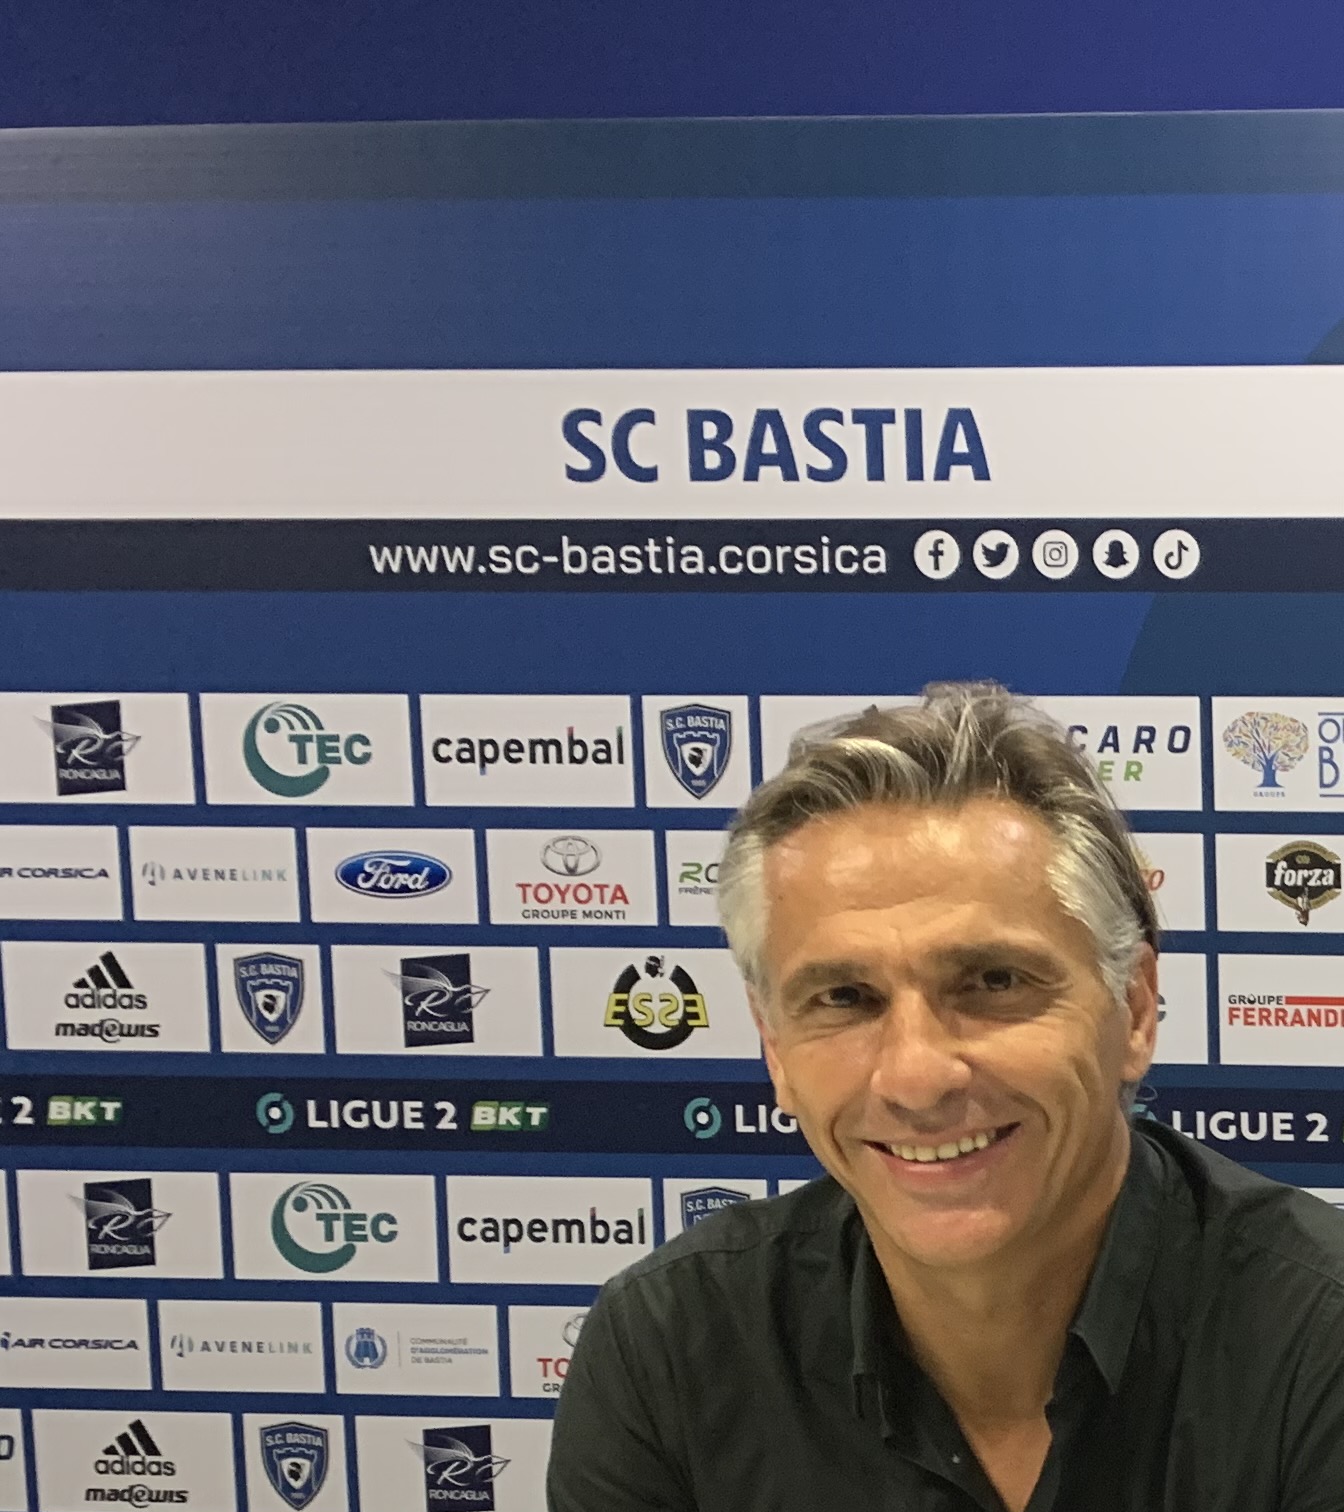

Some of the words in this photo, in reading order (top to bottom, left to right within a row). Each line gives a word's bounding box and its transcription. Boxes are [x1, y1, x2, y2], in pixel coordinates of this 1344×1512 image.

[562, 407, 658, 485] SC
[689, 407, 991, 483] BASTIA
[370, 535, 887, 577] www.sc-bastia.corsica
[289, 733, 372, 765] TEC
[432, 726, 624, 775] capembal
[357, 858, 429, 891] Ford
[1273, 864, 1335, 887] forza
[516, 883, 629, 905] TOYOTA
[522, 909, 577, 920] GROUPE
[582, 909, 626, 920] MONTI
[64, 988, 147, 1009] adidas
[407, 1020, 470, 1032] RONCAGLIA
[307, 1100, 424, 1130] LIGUE
[434, 1102, 458, 1130] 2
[472, 1106, 548, 1127] BKT
[735, 1104, 798, 1133] LIG
[1171, 1111, 1295, 1142] LIGUE
[1306, 1113, 1329, 1143] 2
[316, 1213, 398, 1242] TEC
[457, 1207, 645, 1254] capembal
[12, 1338, 44, 1350] AIR
[49, 1338, 138, 1351] CORSICA
[200, 1341, 312, 1355] AVENELINK
[94, 1456, 176, 1477] adidas
[429, 1490, 490, 1501] RONCAGLIA
